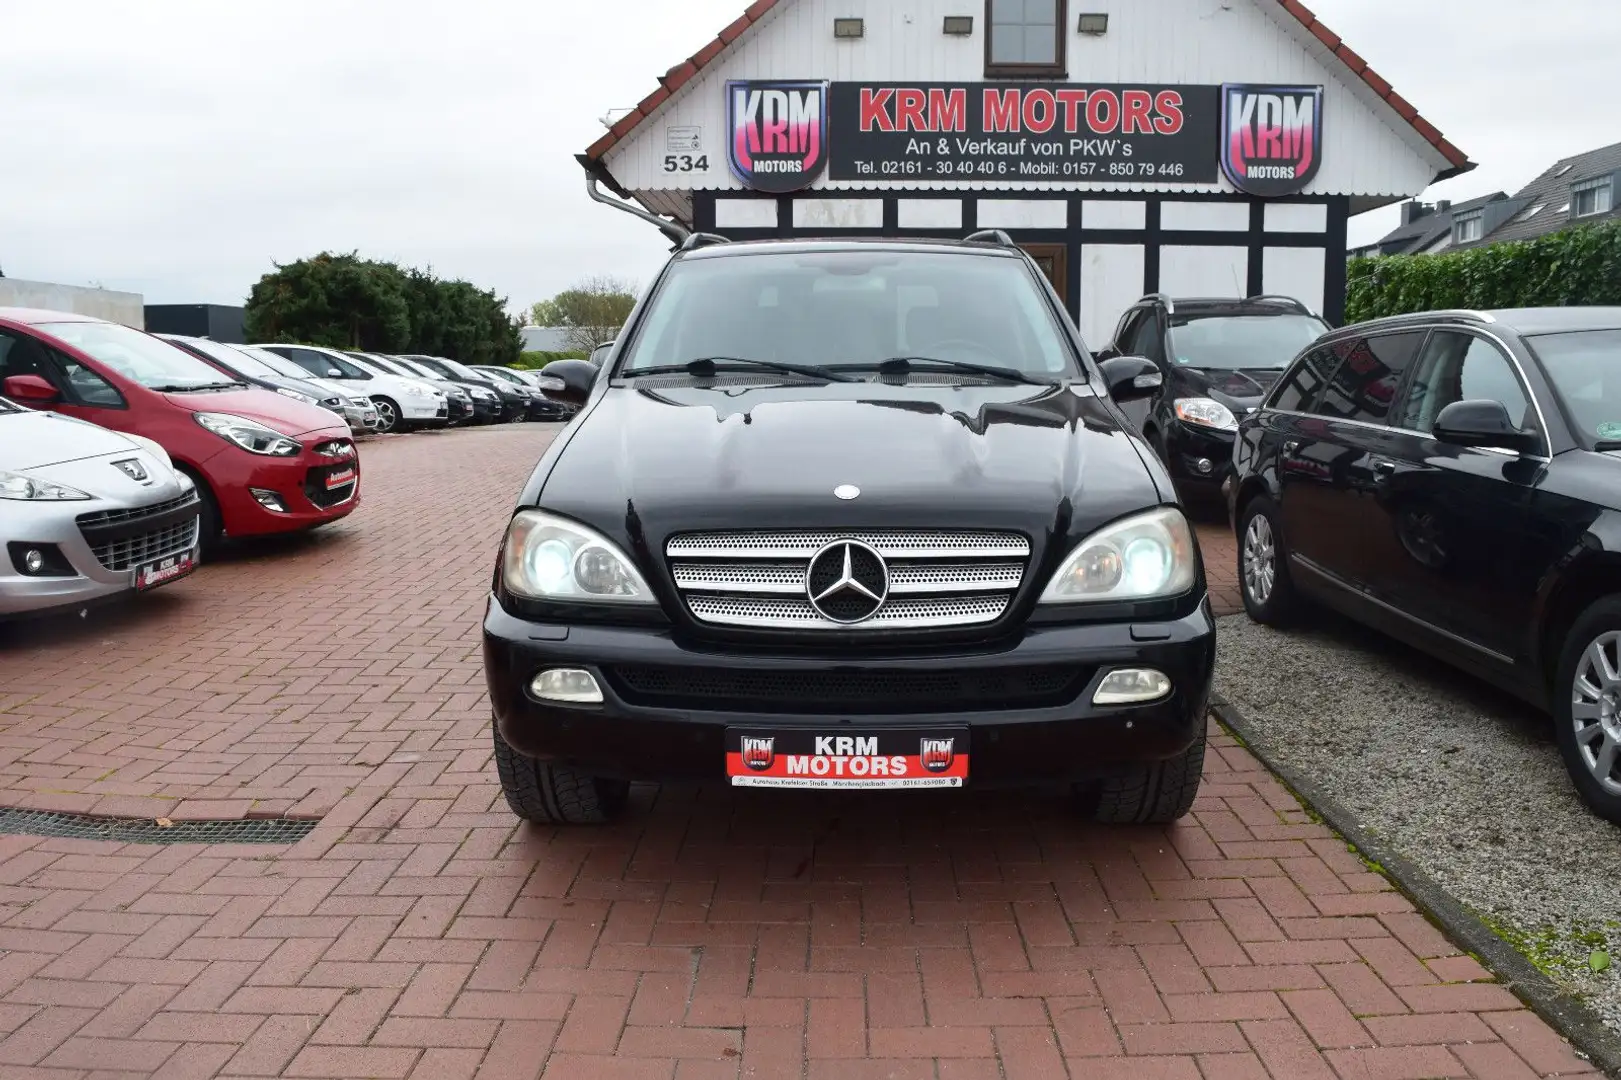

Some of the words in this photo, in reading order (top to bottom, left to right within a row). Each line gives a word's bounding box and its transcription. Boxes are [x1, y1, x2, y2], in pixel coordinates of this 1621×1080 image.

[860, 88, 967, 132] KRM
[982, 88, 1184, 135] MOTORS
[735, 90, 820, 171] KRM
[1230, 93, 1314, 178] KRM
[905, 138, 931, 154] An
[937, 138, 951, 154] &
[956, 138, 1027, 155] Verkauf
[1031, 141, 1064, 156] von
[663, 155, 710, 172] 534
[753, 160, 803, 174] MOTORS
[854, 161, 878, 174] Tel.
[881, 161, 922, 174] 02161
[936, 161, 953, 174] 30
[957, 161, 974, 174] 40
[977, 161, 994, 174] 40
[998, 161, 1007, 174] 6
[1019, 161, 1059, 175] Mobil:
[1063, 162, 1097, 175] 0157
[1109, 163, 1134, 175] 850
[1138, 163, 1155, 175] 79
[1158, 163, 1184, 176] 446
[1247, 165, 1295, 179] MOTORS
[815, 736, 878, 756] KRM
[787, 755, 908, 775] MOTORS
